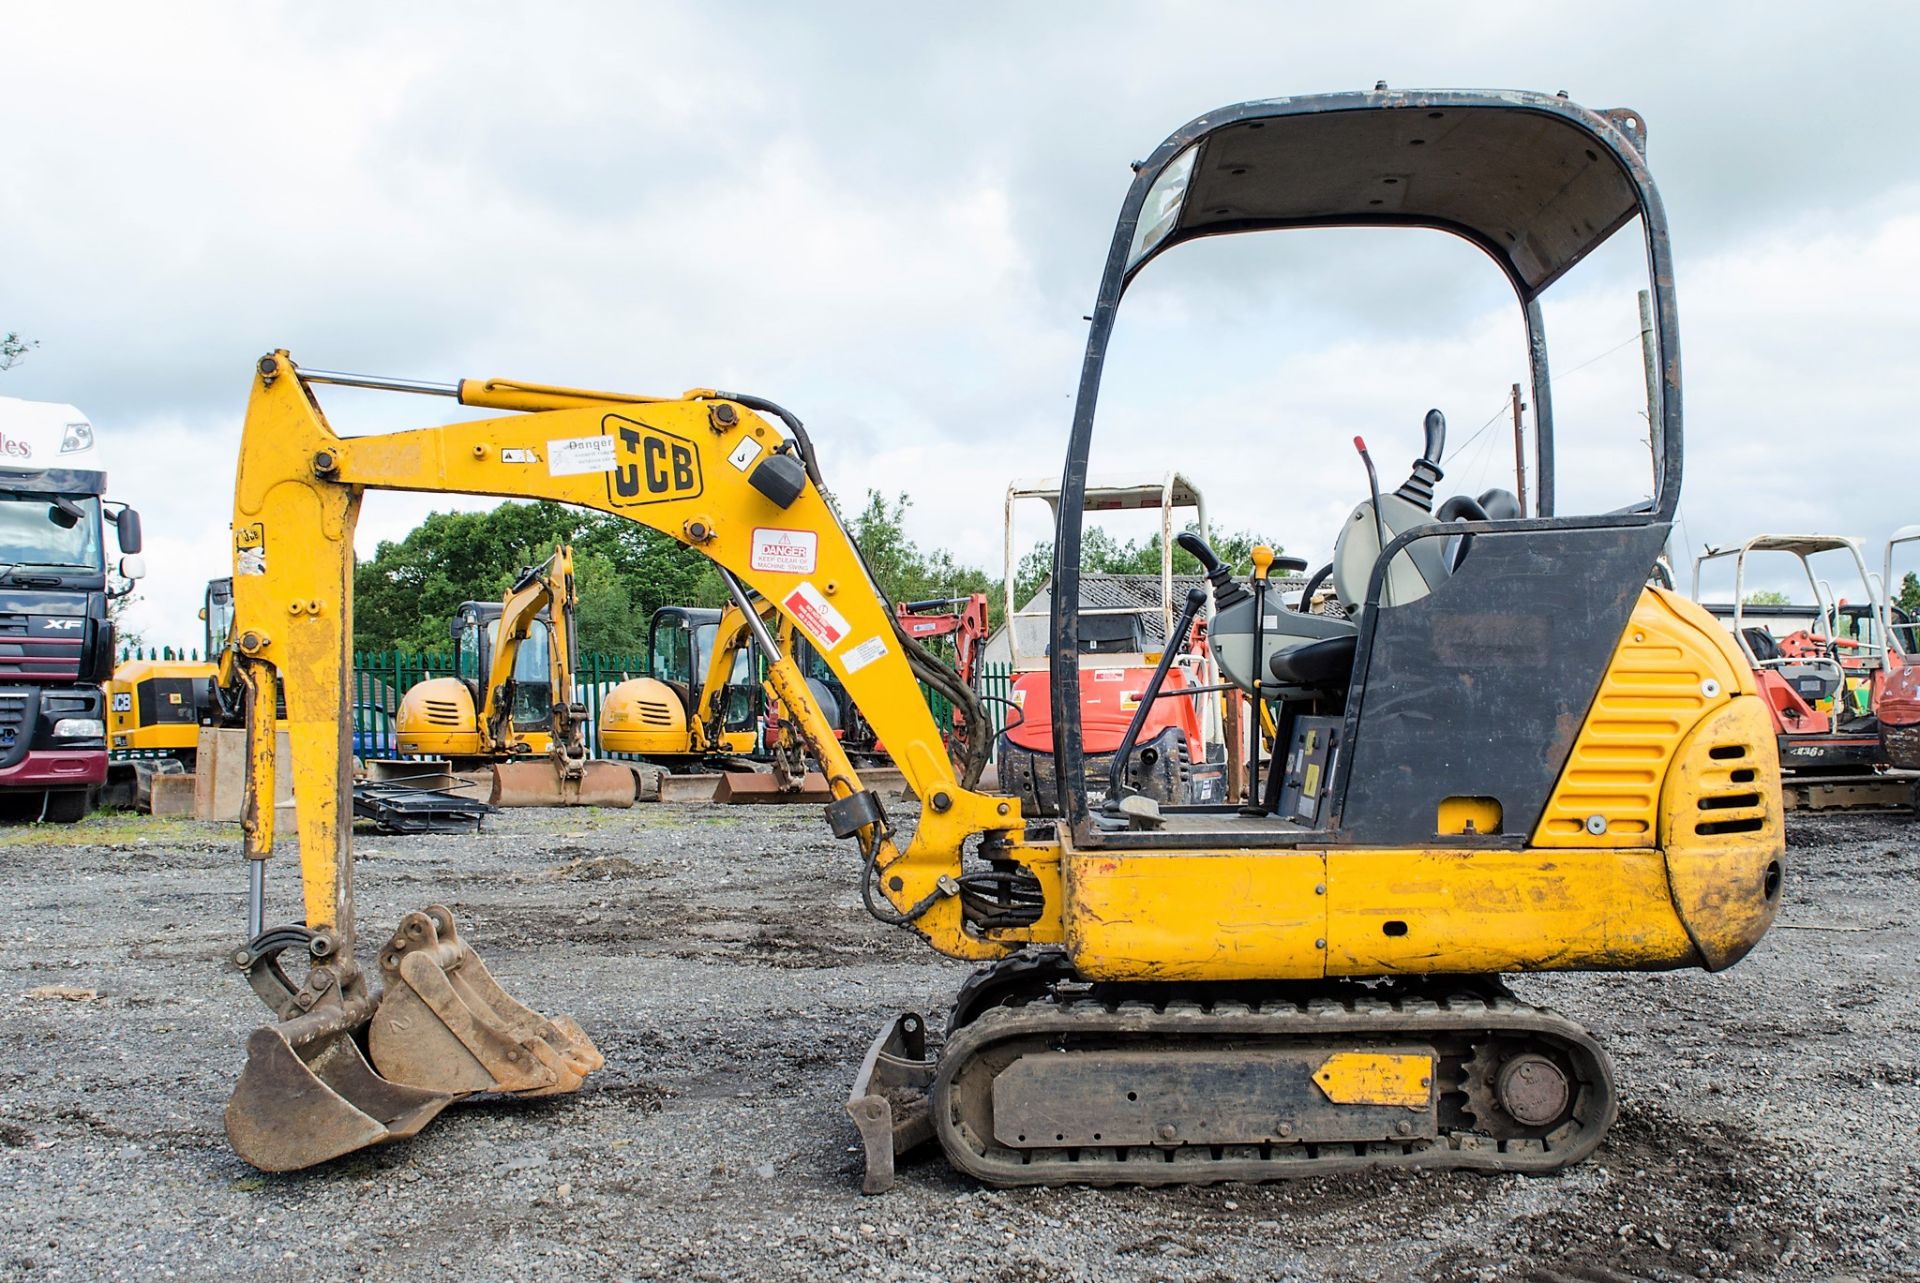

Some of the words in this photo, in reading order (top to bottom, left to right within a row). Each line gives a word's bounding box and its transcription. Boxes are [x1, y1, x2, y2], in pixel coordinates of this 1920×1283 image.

[569, 439, 611, 451] Danger
[615, 427, 694, 497] JCB
[762, 545, 806, 557] DANGER
[43, 619, 83, 630] XF
[112, 693, 131, 711] JCB
